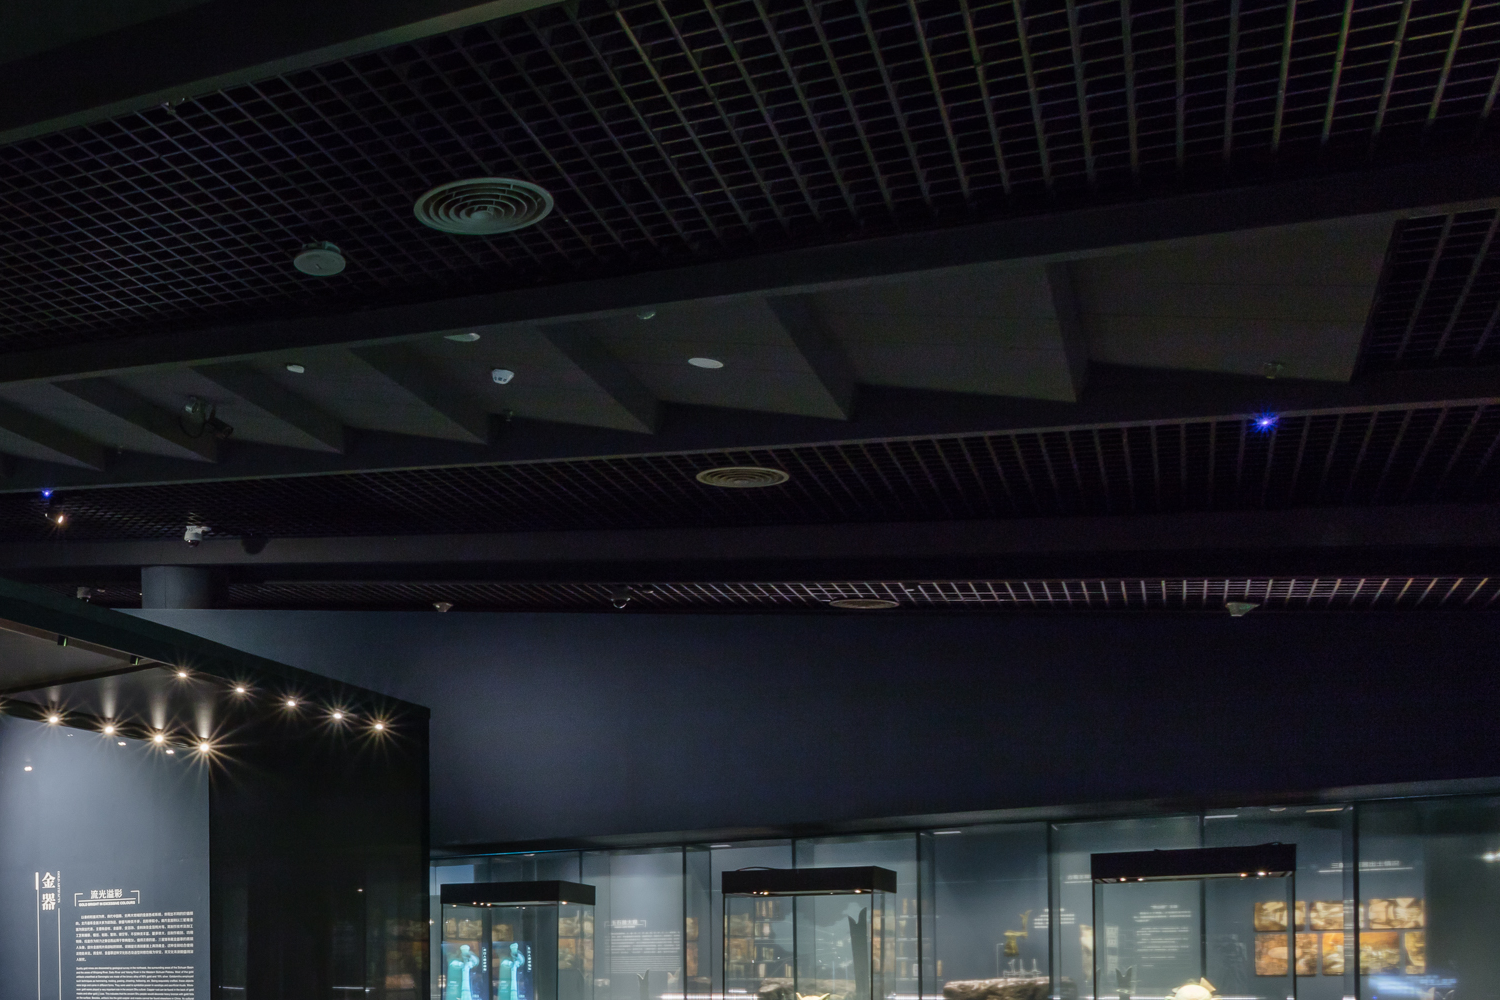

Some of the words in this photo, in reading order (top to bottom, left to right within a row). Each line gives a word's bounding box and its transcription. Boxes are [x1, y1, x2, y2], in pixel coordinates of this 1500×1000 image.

[41, 871, 56, 911] 金器
[90, 888, 123, 899] 流光溢彩
